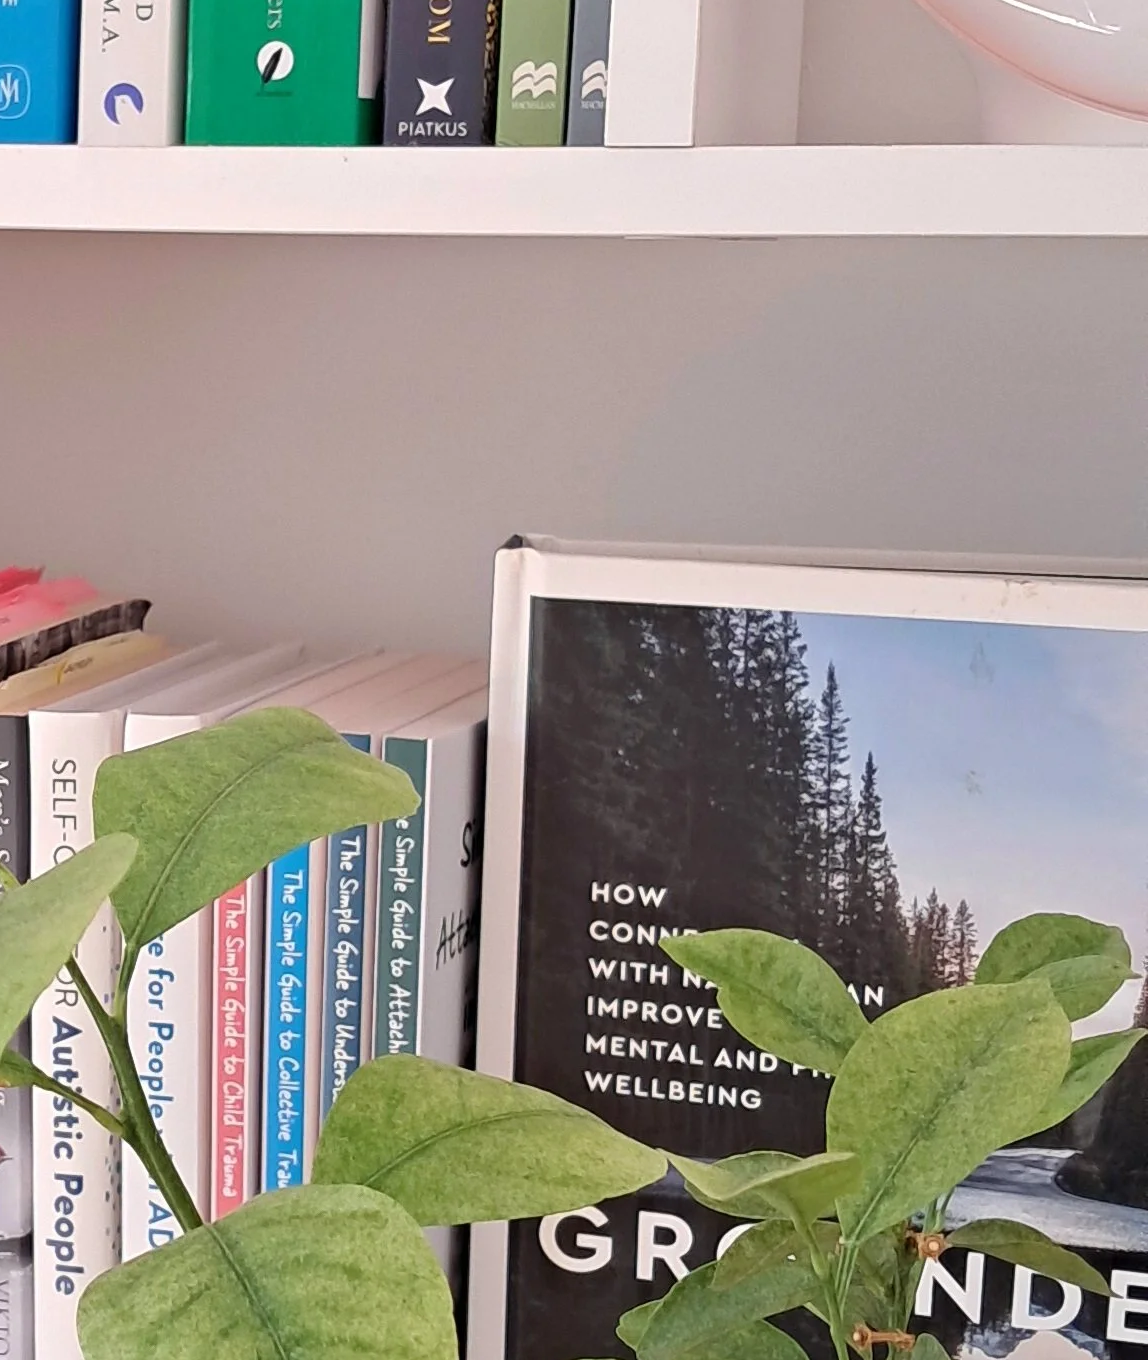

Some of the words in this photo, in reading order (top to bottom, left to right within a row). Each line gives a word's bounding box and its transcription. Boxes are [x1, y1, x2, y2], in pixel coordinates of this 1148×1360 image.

[225, 895, 244, 931] The
[590, 881, 668, 909] HOW
[219, 934, 245, 993] Simple
[221, 997, 244, 1048] Guide
[586, 996, 724, 1030] IMPROVE
[224, 1054, 243, 1076] to
[585, 1032, 705, 1067] MENTAL
[713, 1048, 780, 1075] AND
[221, 1080, 244, 1127] Child
[584, 1069, 763, 1111] WELLBEING
[221, 1134, 241, 1199] Trauma
